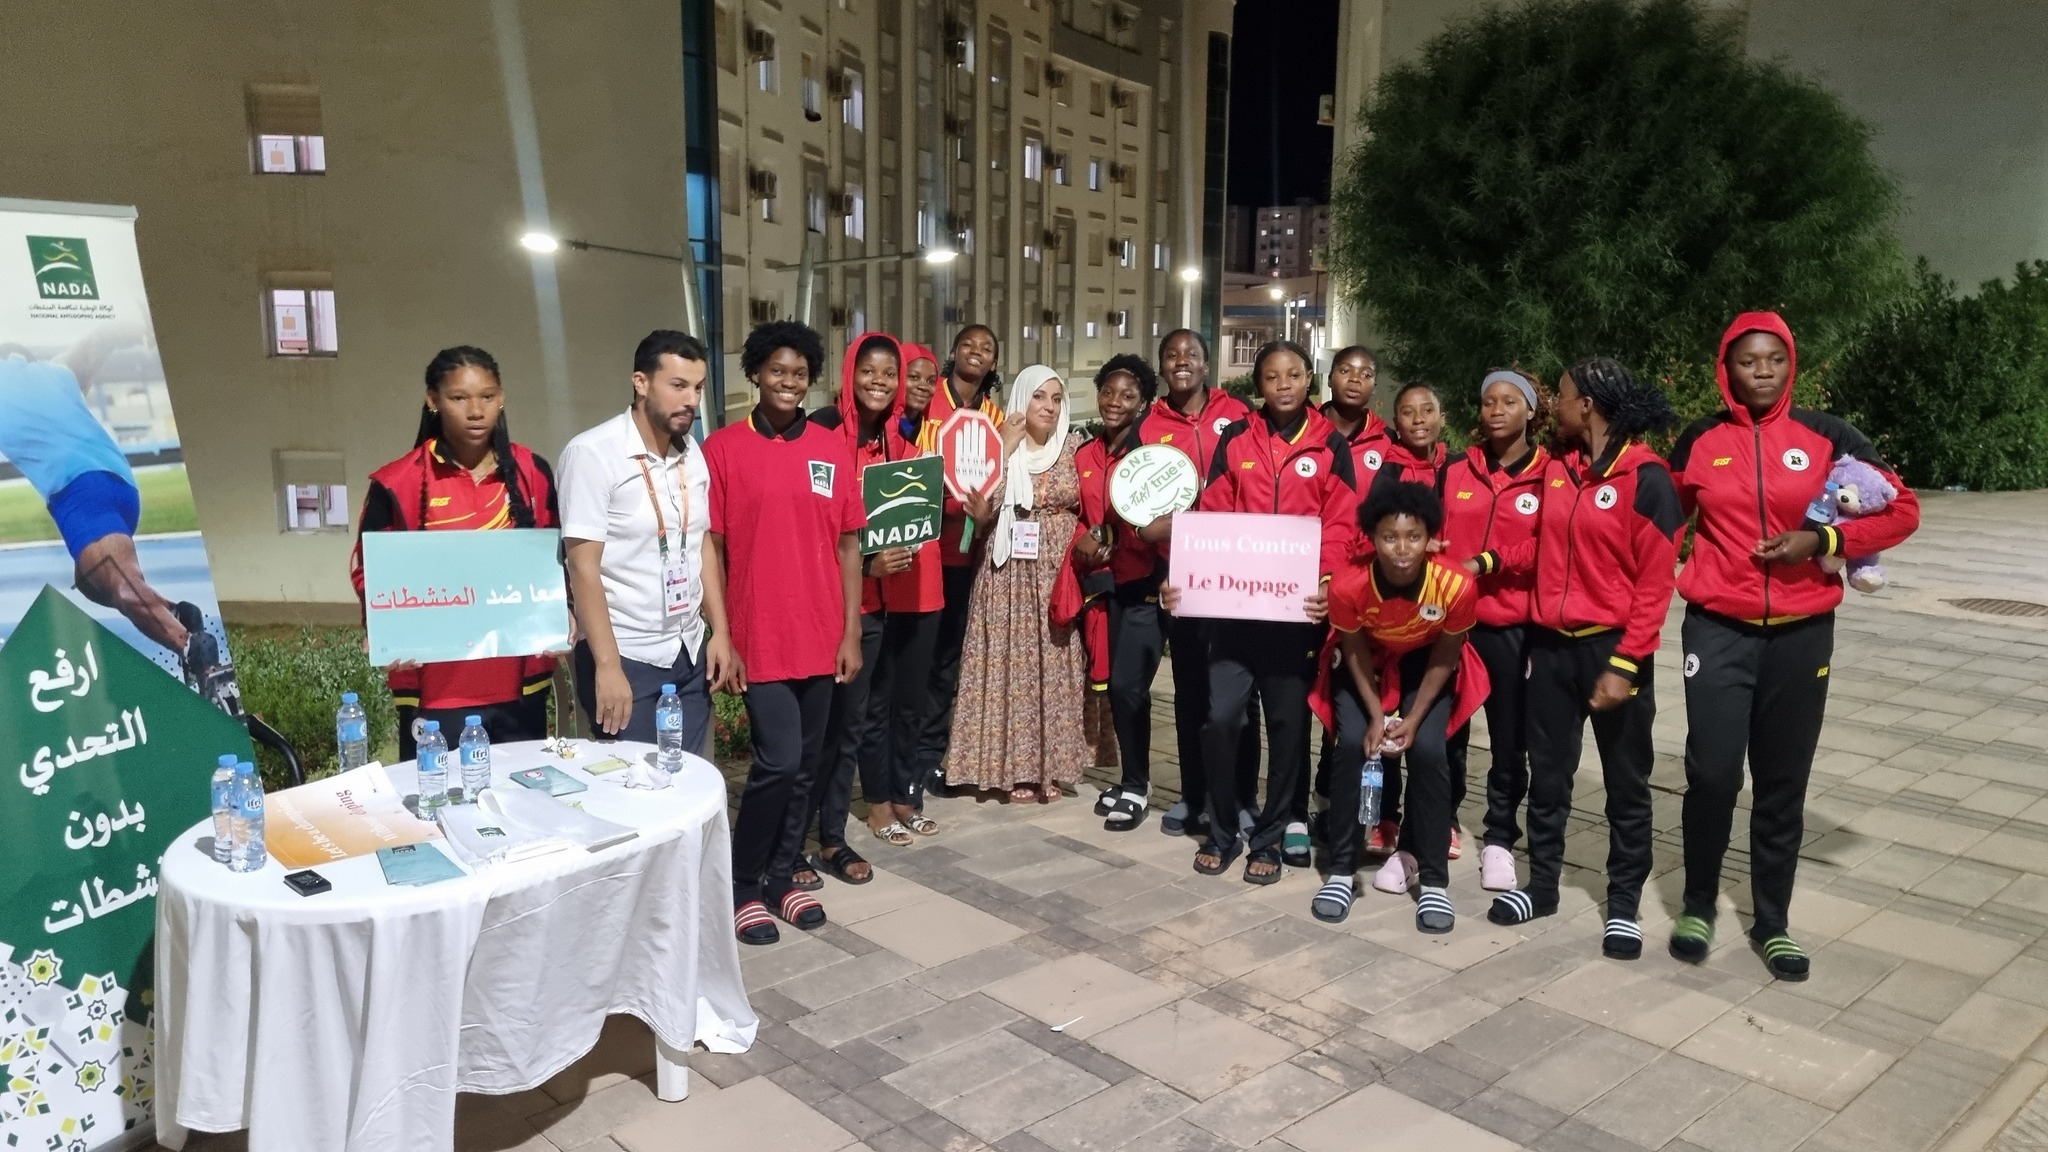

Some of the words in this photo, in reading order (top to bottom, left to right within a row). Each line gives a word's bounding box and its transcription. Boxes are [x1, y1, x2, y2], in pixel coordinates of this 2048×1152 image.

[42, 281, 93, 296] NADA
[1120, 451, 1152, 479] ONE
[1150, 465, 1178, 488] true
[868, 519, 933, 548] NADA
[1181, 533, 1231, 552] Tous
[1236, 534, 1312, 556] Contre
[370, 585, 477, 611] المنشطات
[486, 583, 522, 605] ضد
[1188, 573, 1212, 590] Le
[1219, 573, 1300, 598] Dopage
[29, 641, 98, 712] ارفع
[19, 706, 148, 795] التحدي
[64, 799, 146, 850] بدون
